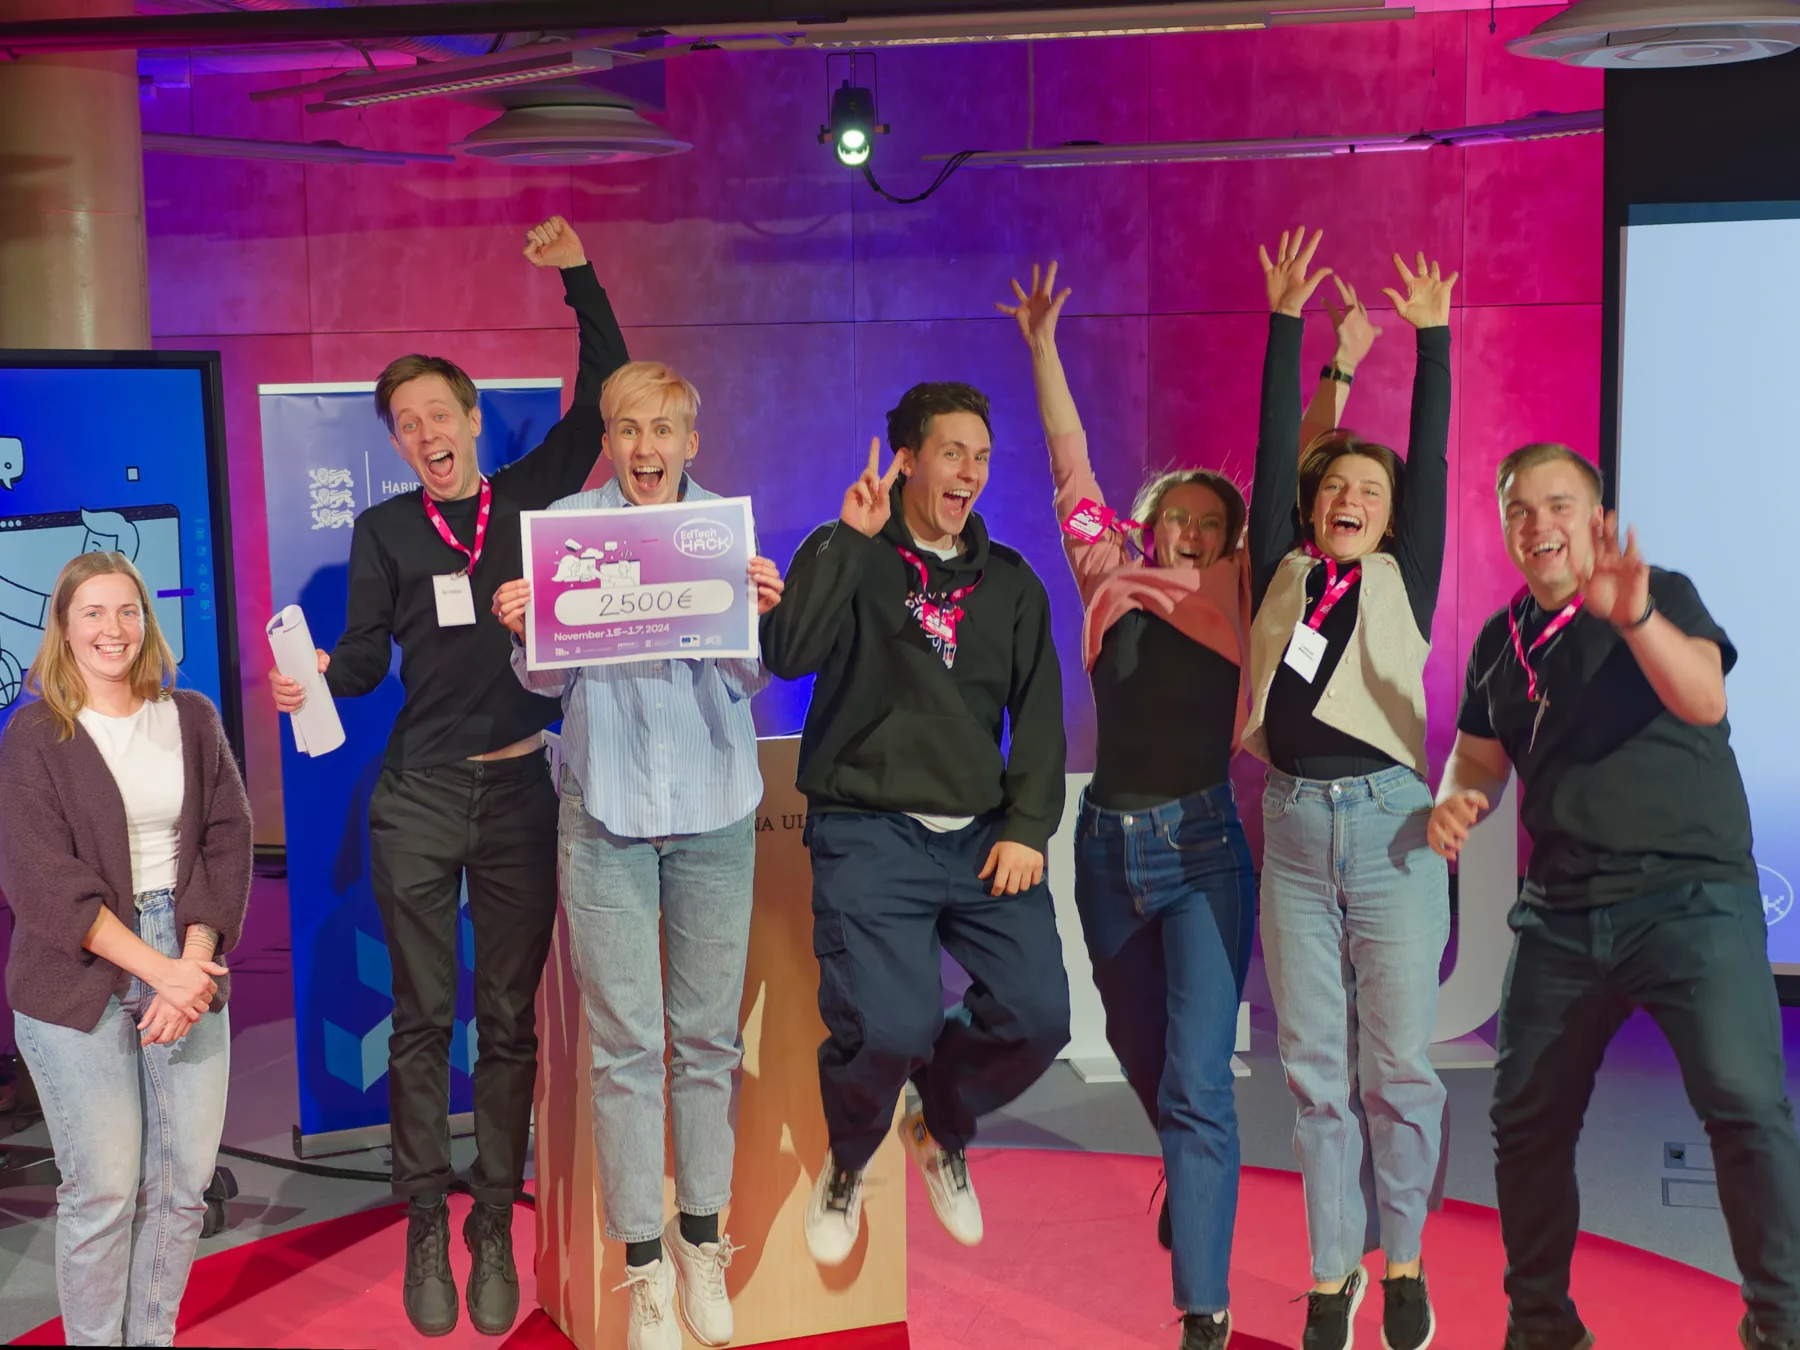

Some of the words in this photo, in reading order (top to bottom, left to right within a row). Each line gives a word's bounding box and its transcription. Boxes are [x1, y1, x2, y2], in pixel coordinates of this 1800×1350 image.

[681, 528, 717, 540] EdTech
[681, 537, 729, 552] HACK
[600, 588, 693, 617] 2500€
[554, 629, 605, 641] November
[645, 623, 670, 634] 2024
